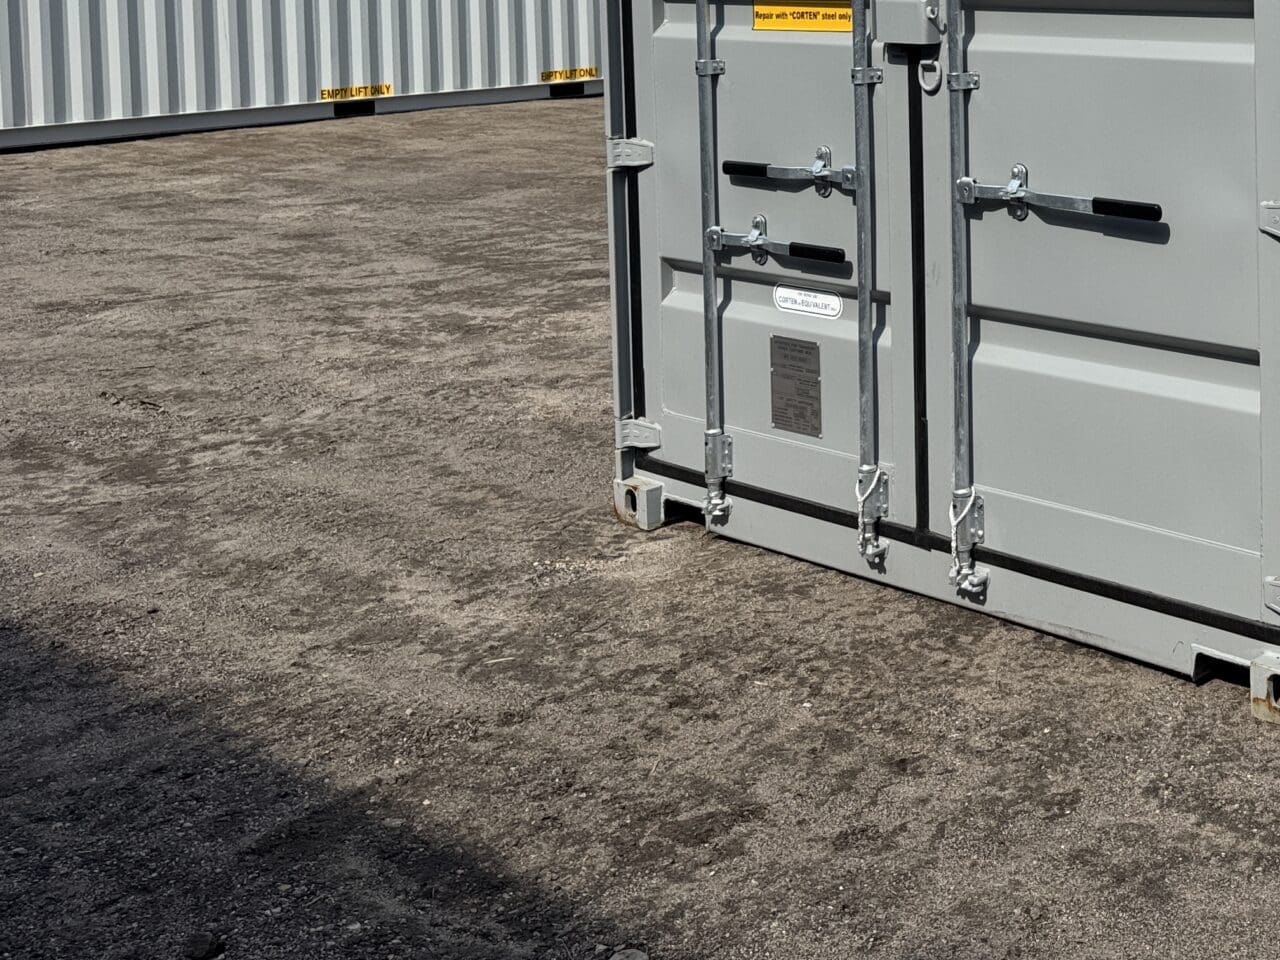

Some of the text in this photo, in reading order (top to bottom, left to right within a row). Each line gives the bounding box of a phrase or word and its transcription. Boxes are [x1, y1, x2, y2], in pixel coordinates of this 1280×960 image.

[755, 11, 774, 21] Repair
[775, 11, 788, 19] with
[838, 13, 851, 22] only
[320, 84, 391, 100] EMPTY LIFT ONLY
